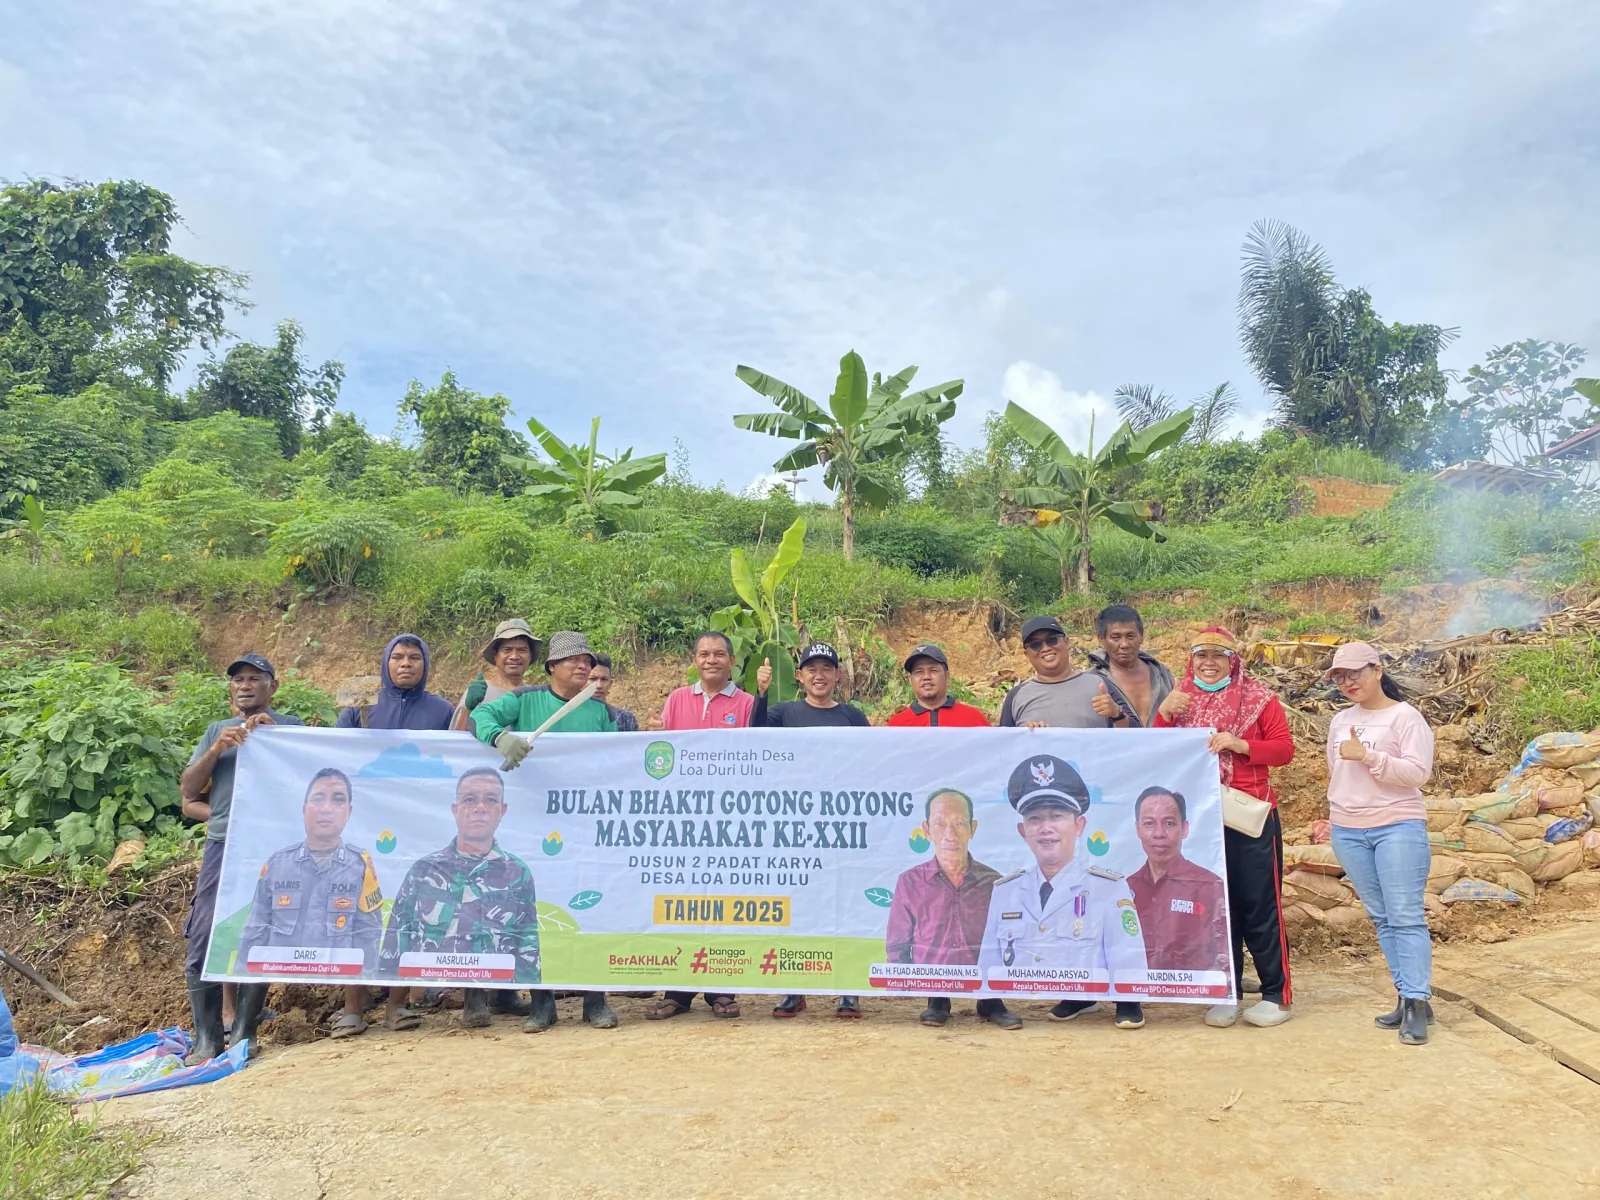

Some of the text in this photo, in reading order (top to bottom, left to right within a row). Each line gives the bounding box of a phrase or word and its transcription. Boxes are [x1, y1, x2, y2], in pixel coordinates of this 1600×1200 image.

[809, 649, 832, 657] MAJU
[680, 749, 794, 762] Pemerintah Desa
[680, 764, 763, 776] Loa Duri Ulu
[546, 790, 914, 816] BULAN BHAKTI GOTONG ROYONG
[594, 820, 868, 849] MASYARAKAT KE-XXII
[628, 856, 823, 870] DUSUN 2 PADAT KARYA
[640, 872, 810, 886] DESA LOA DURI ULU
[274, 880, 357, 892] DARIS POLRI
[664, 900, 784, 922] TAHUN 2025
[294, 950, 317, 960] DARIS
[710, 947, 746, 958] bangga
[780, 948, 833, 960] Bersama
[436, 956, 480, 966] NASRULLAH
[609, 954, 678, 966] BerAKHLAK
[710, 956, 752, 967] melayani
[780, 960, 832, 971] KitaBISA
[421, 969, 442, 977] Babinsa
[444, 970, 458, 978] Desa
[709, 966, 744, 976] bangsa
[872, 966, 883, 975] Drs.
[886, 968, 892, 976] H.
[893, 968, 911, 976] FUAD
[1008, 969, 1090, 980] MUHAMMAD ARSYAD
[1148, 972, 1192, 982] NURDIN, S.Pd
[887, 980, 904, 988] Ketua
[1013, 982, 1032, 992] Kepala
[1034, 982, 1048, 990] Desa
[1050, 983, 1060, 991] Loa
[1060, 984, 1074, 992] Duri
